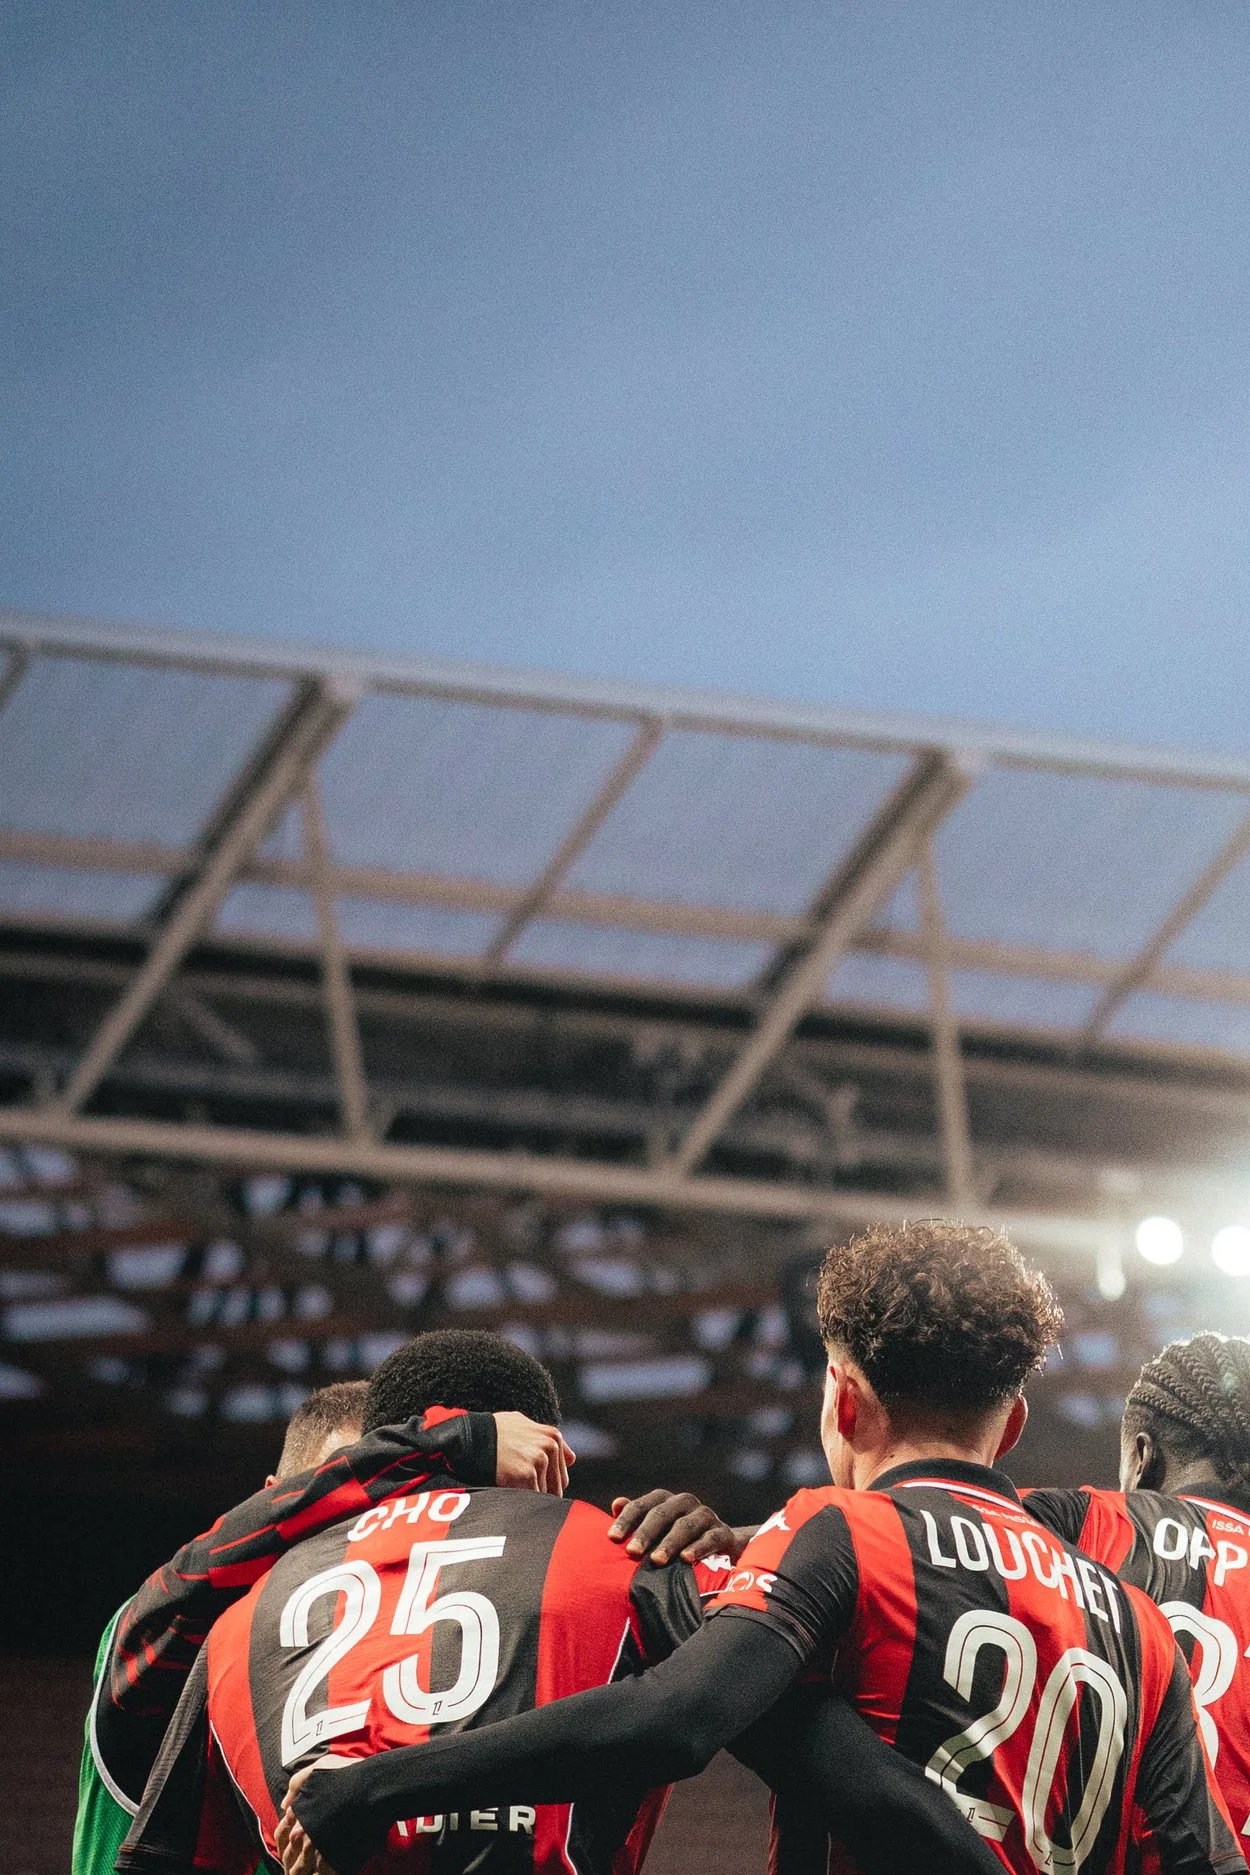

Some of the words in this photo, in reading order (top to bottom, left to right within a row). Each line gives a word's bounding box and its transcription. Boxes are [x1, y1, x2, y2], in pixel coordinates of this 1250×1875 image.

[347, 1492, 471, 1541] CHO
[1212, 1519, 1244, 1535] ISSA
[920, 1510, 1121, 1634] LOUCHET
[280, 1536, 507, 1767] 25
